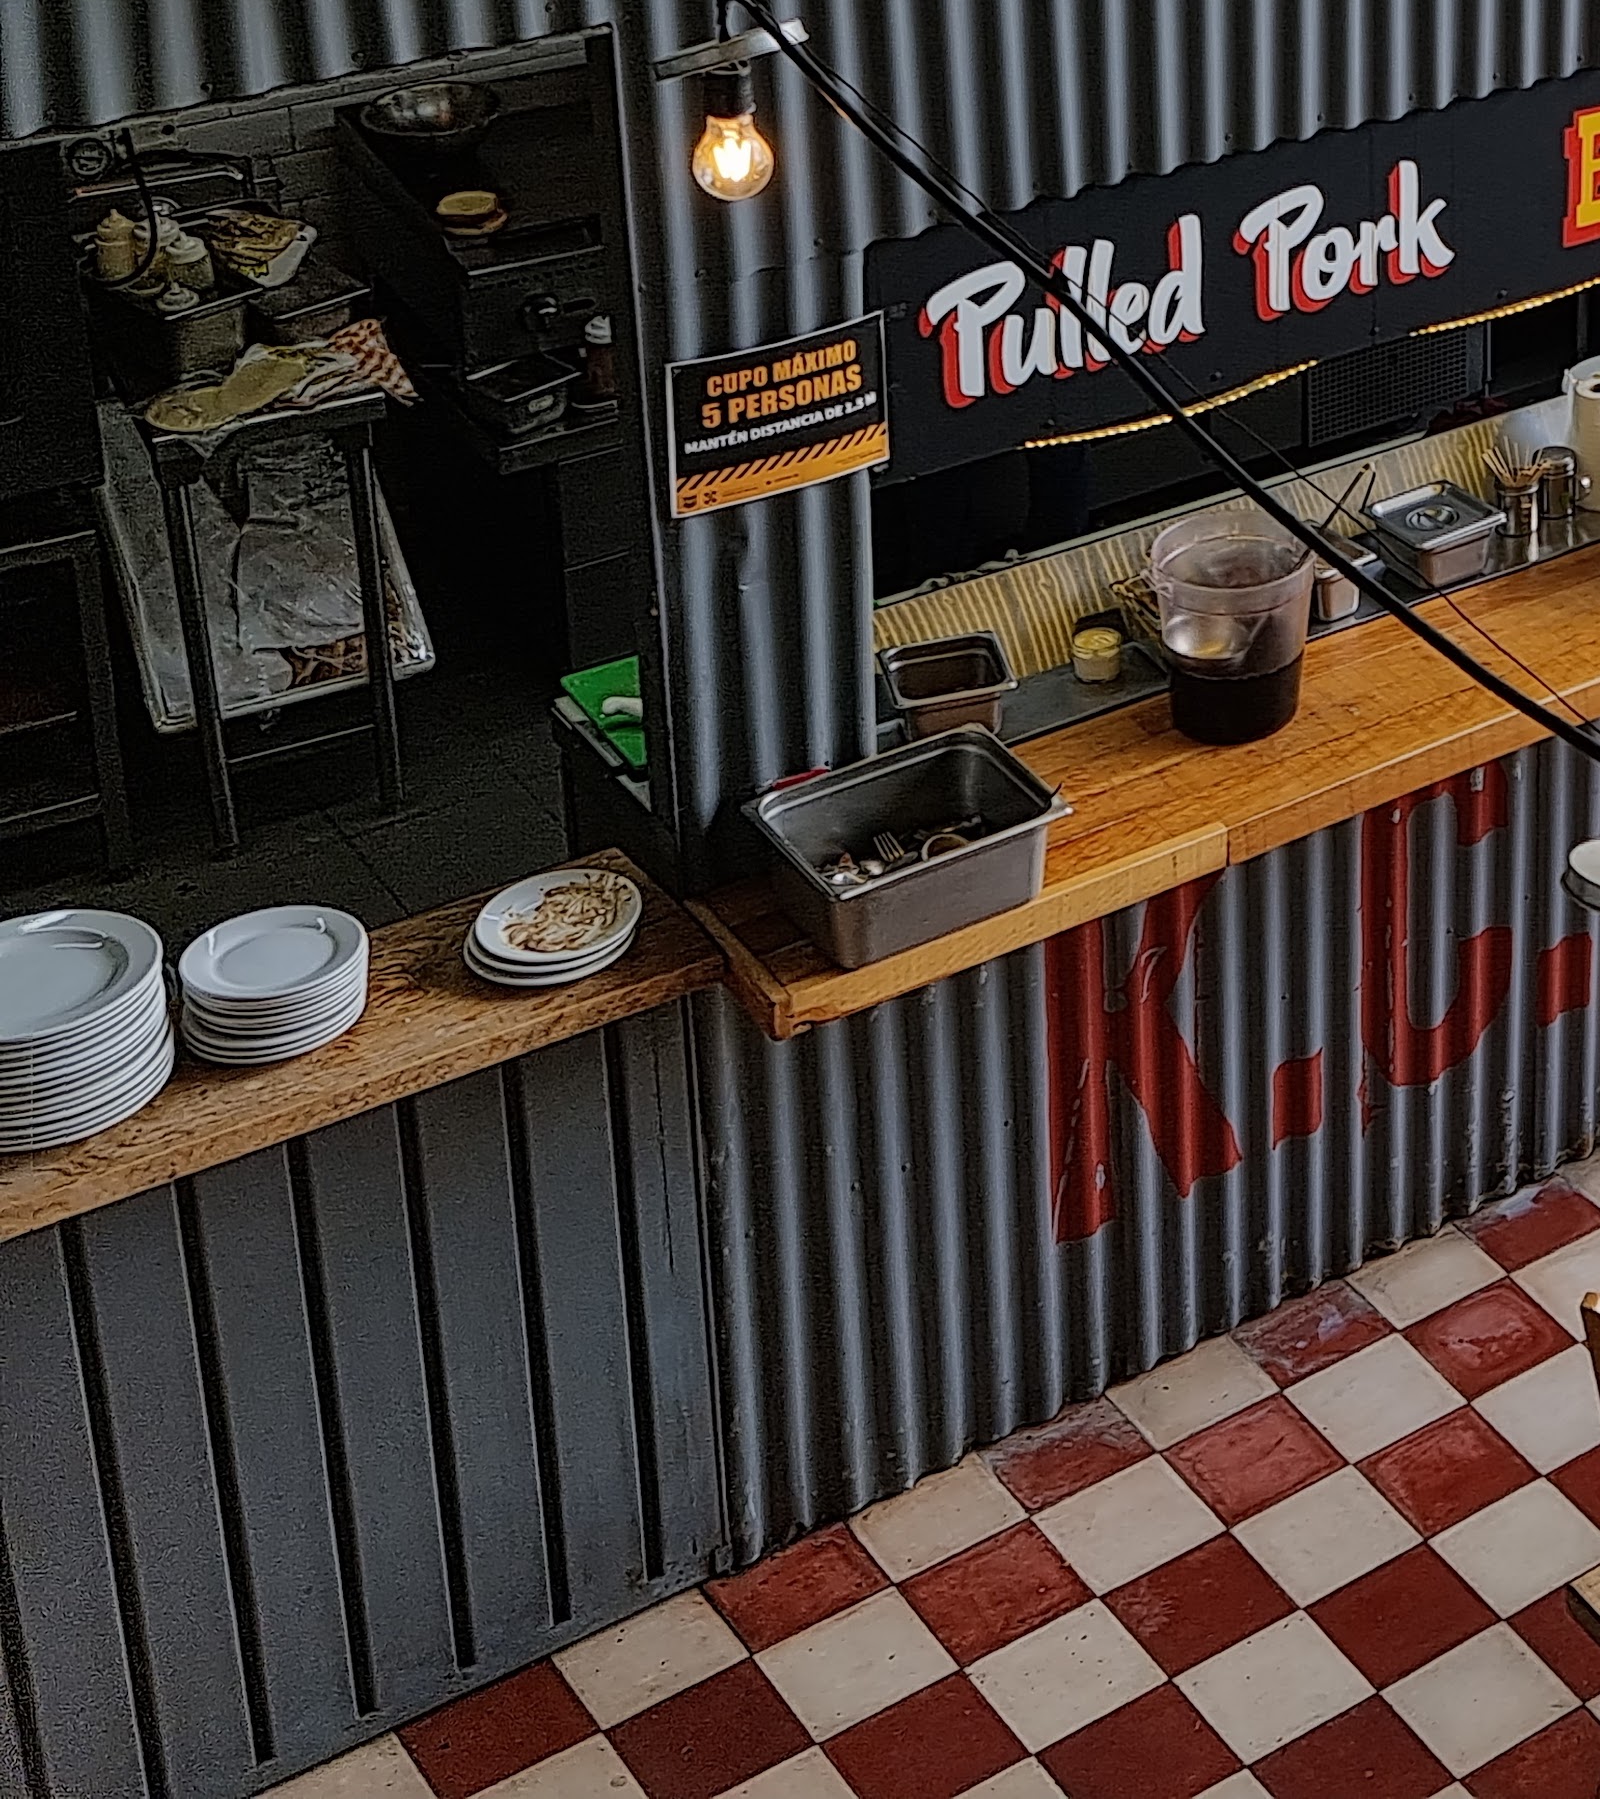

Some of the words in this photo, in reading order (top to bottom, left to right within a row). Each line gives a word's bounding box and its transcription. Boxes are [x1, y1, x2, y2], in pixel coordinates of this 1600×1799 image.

[918, 214, 1204, 408] Pulled
[1233, 160, 1455, 321] Pork
[701, 402, 722, 429] 5
[728, 364, 862, 424] PERSONAS
[707, 365, 768, 397] CUPO
[772, 340, 857, 383] MÁXIMO
[684, 430, 748, 454] MANTÉN
[750, 411, 824, 441] DISTANCIA
[825, 404, 844, 421] DE
